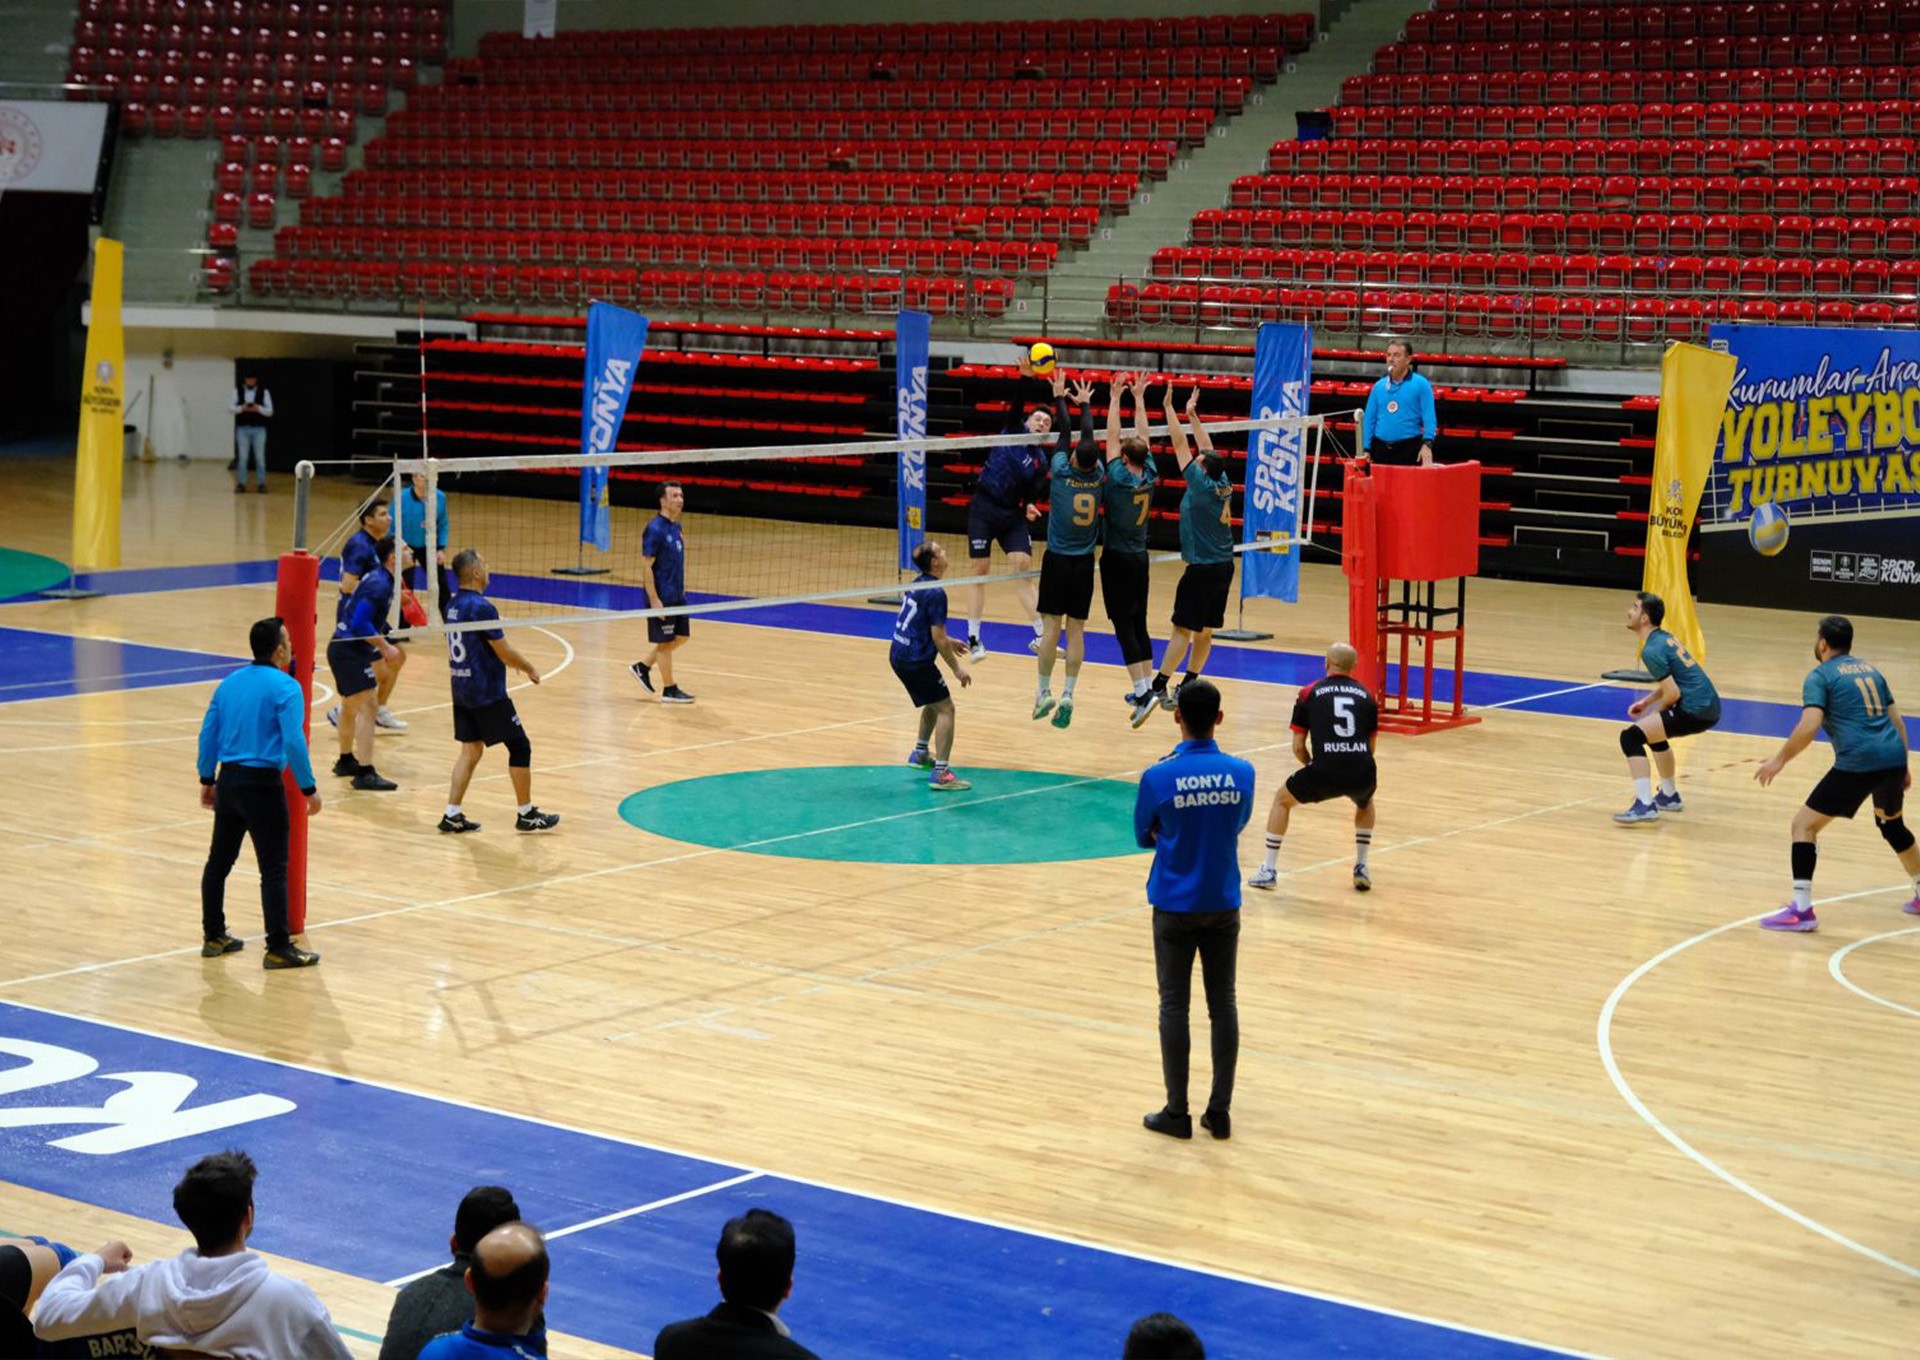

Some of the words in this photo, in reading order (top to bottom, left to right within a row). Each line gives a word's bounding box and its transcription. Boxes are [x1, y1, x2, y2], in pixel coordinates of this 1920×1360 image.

[1728, 354, 1860, 411] Kurumlar
[589, 358, 631, 474] ONYA
[1072, 493, 1096, 527] 9
[1133, 493, 1149, 526] 7
[1219, 499, 1231, 527] 4
[1315, 685, 1340, 698] KONYA
[1340, 685, 1368, 699] BAROSU
[1855, 677, 1883, 716] 11
[1333, 696, 1356, 738] 5
[1323, 742, 1368, 753] RUSLAN
[1175, 773, 1236, 792] KONYA
[1173, 790, 1241, 809] BAROSU
